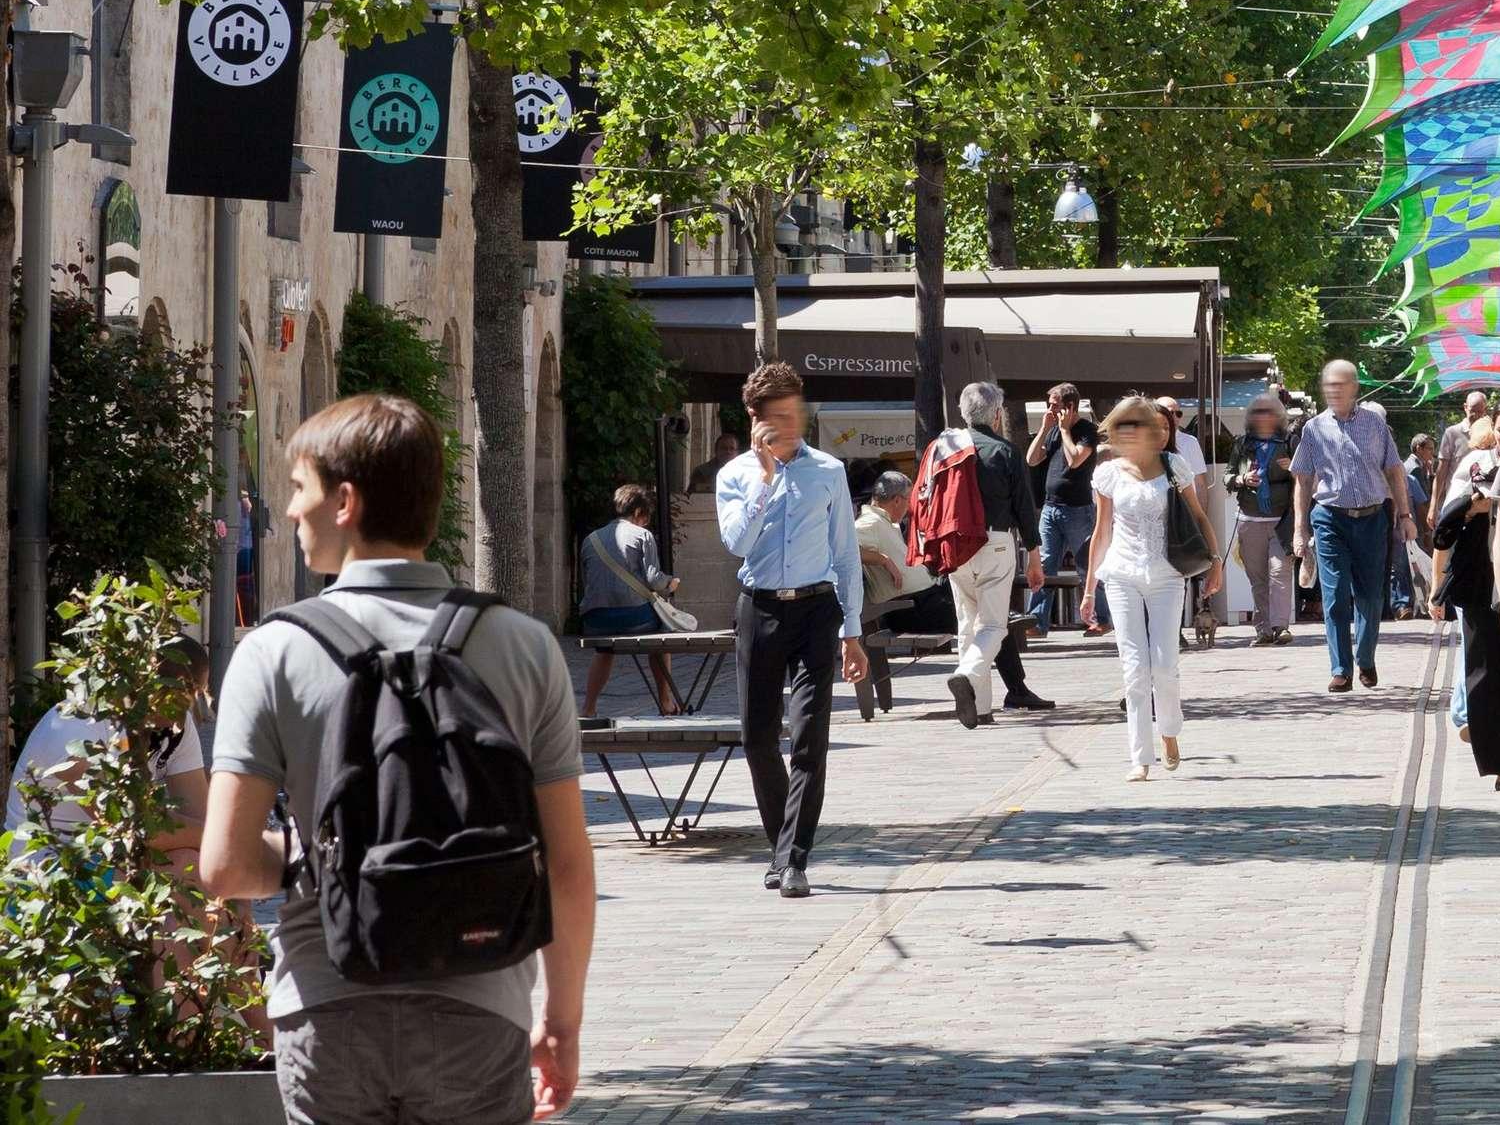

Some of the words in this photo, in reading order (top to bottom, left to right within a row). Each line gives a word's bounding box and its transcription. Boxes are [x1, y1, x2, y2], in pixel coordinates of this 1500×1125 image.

[193, 35, 285, 82] VILLAGE
[362, 77, 432, 104] BERCY
[513, 76, 565, 98] ERCY
[354, 118, 434, 160] VILLAGE
[371, 219, 404, 230] WAOU
[606, 248, 639, 258] MAISON
[804, 353, 913, 373] espressame
[860, 433, 895, 447] Partie
